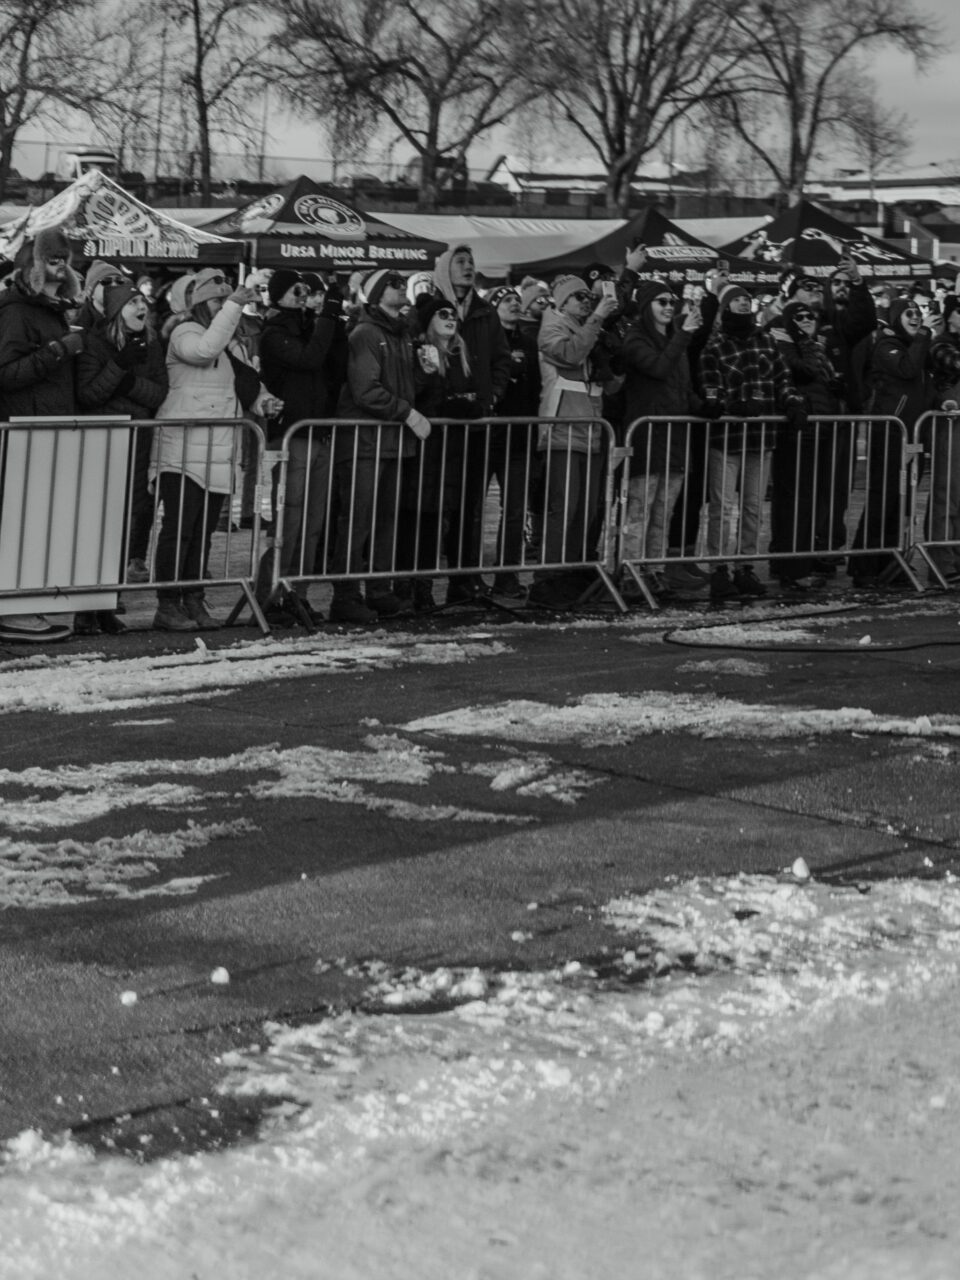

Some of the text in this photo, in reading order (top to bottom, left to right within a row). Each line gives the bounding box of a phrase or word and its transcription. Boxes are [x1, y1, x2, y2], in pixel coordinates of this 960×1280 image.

[280, 243, 428, 260] URSA MINOR BREWING
[652, 247, 711, 256] INVICTUS
